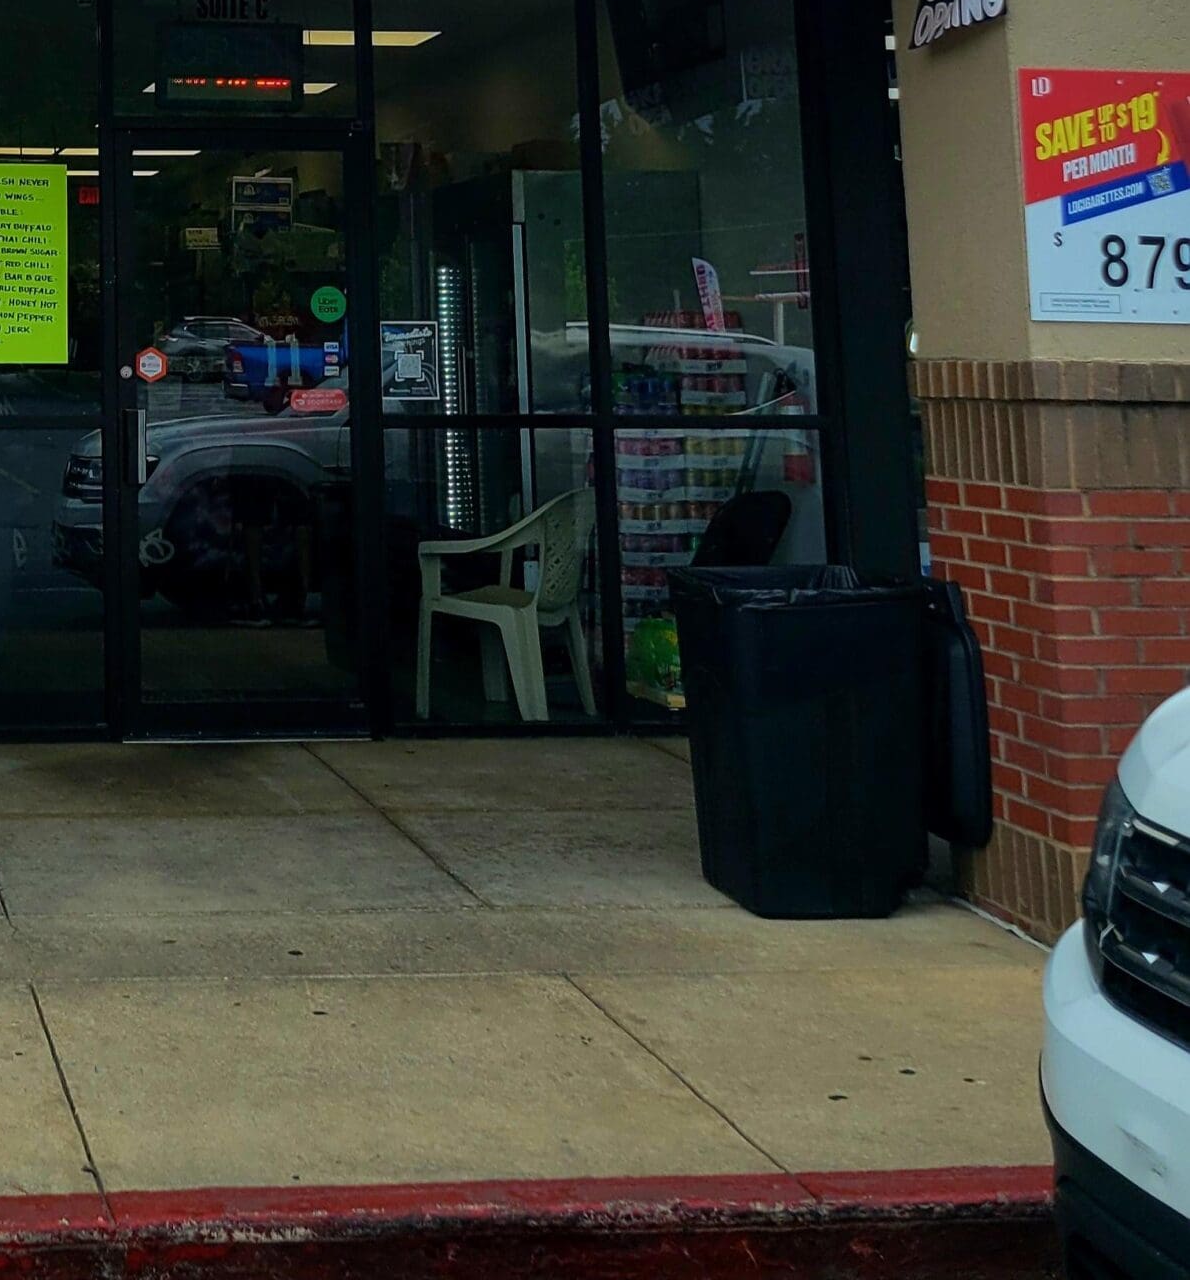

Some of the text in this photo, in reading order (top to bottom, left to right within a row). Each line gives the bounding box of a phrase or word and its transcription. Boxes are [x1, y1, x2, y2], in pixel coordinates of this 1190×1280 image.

[1031, 77, 1051, 97] LD
[1098, 103, 1115, 124] UP
[1035, 107, 1097, 160] SAVE
[1100, 122, 1117, 143] TO
[1062, 143, 1136, 182] PER MONTH
[19, 178, 49, 187] NEVER
[13, 223, 52, 232] BUFFALO
[22, 236, 46, 244] CHILI
[1053, 232, 1063, 247] $
[30, 248, 58, 256] SUGAR
[5, 260, 21, 268] RED
[24, 261, 50, 269] CHILI
[4, 272, 23, 281] BAR
[35, 274, 54, 282] QUE
[18, 285, 56, 295] BUFFALO
[9, 298, 37, 308] HONEY
[40, 300, 58, 309] HOT
[17, 312, 53, 322] PEPPER
[5, 325, 31, 334] JERK
